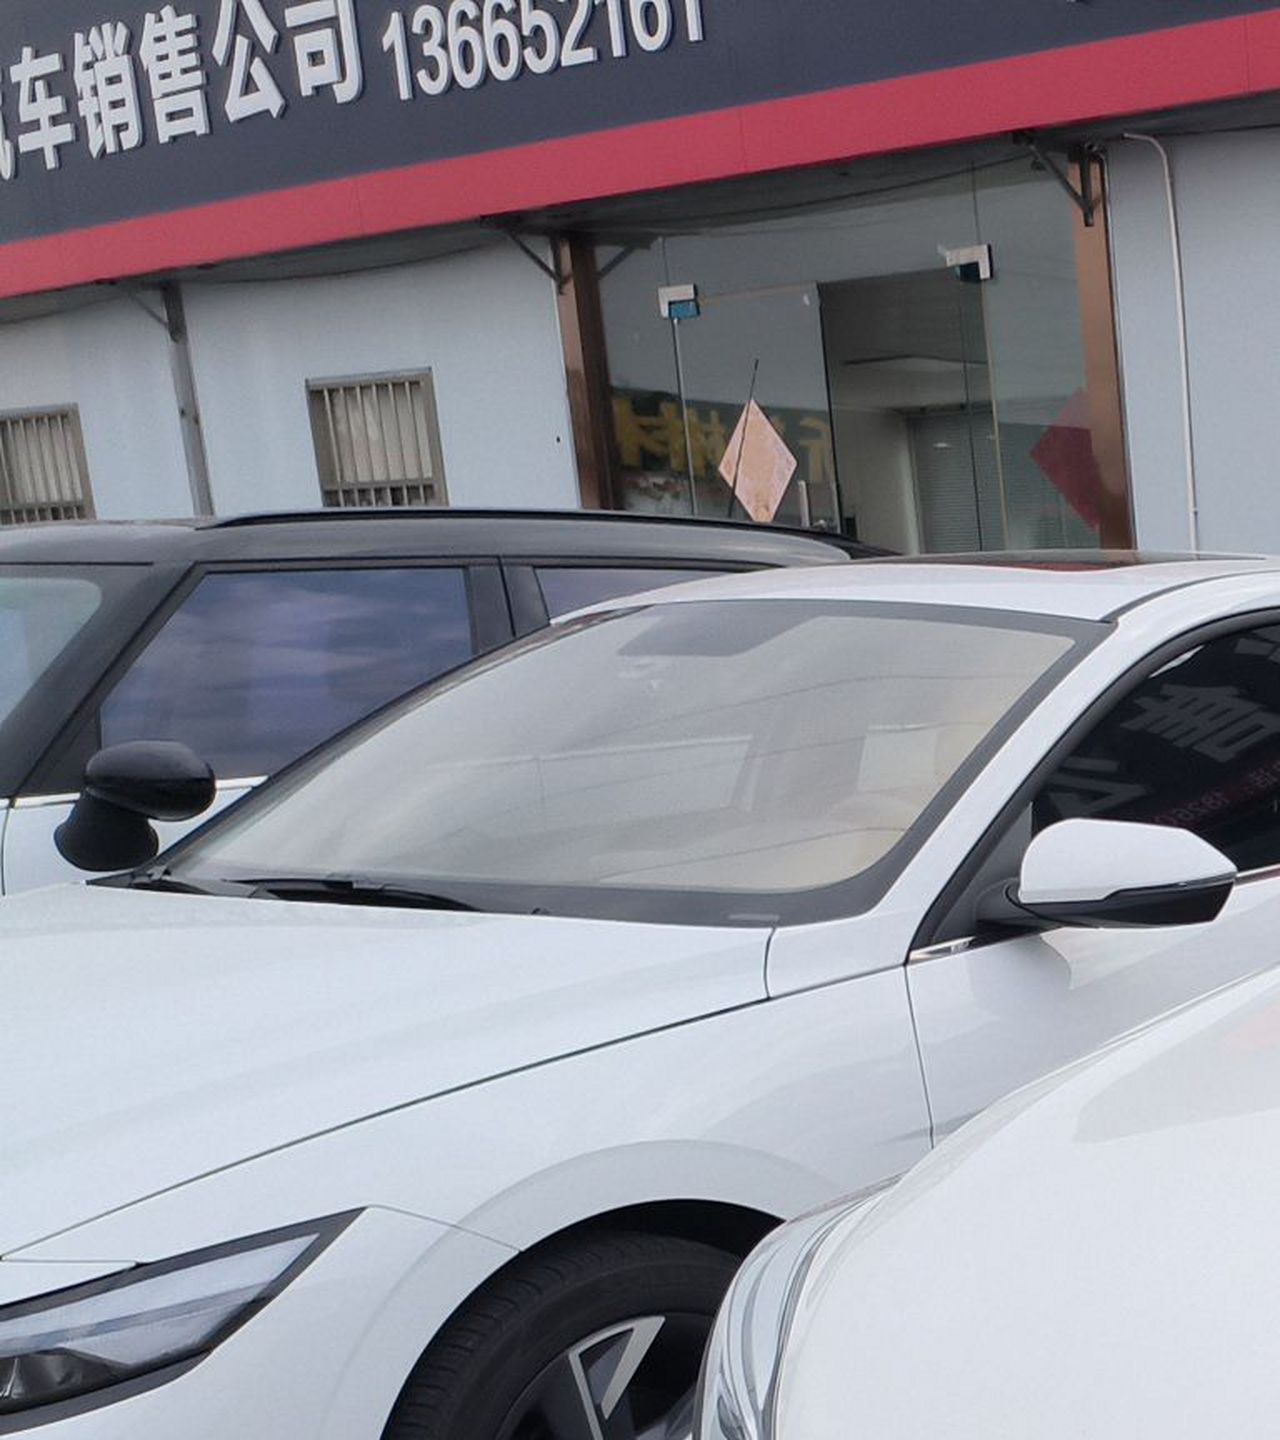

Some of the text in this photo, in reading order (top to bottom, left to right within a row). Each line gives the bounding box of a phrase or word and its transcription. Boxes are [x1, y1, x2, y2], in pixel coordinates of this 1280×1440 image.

[0, 0, 363, 181] 车销售公司
